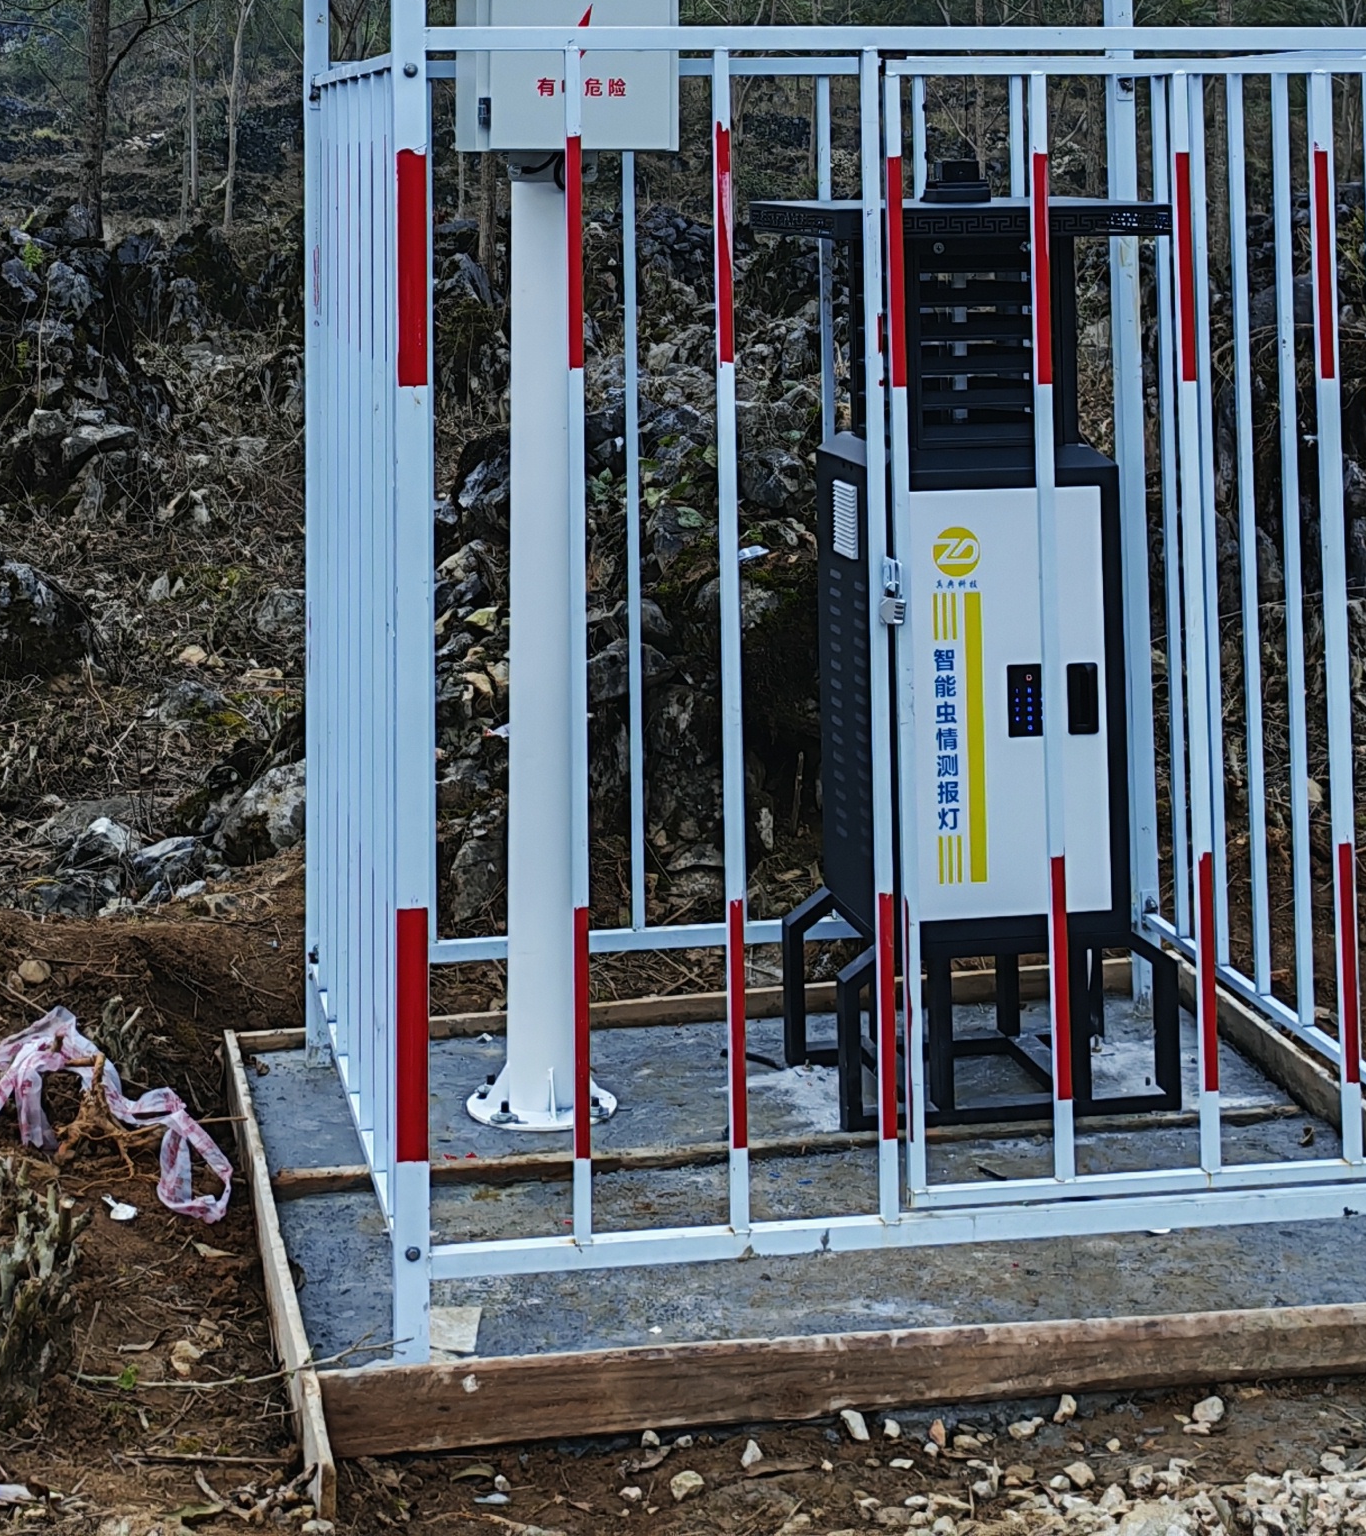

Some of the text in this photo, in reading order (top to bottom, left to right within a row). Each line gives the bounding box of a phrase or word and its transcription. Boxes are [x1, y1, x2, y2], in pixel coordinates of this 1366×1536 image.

[537, 77, 627, 97] 有危险
[933, 648, 960, 831] 智能虫情测报灯
